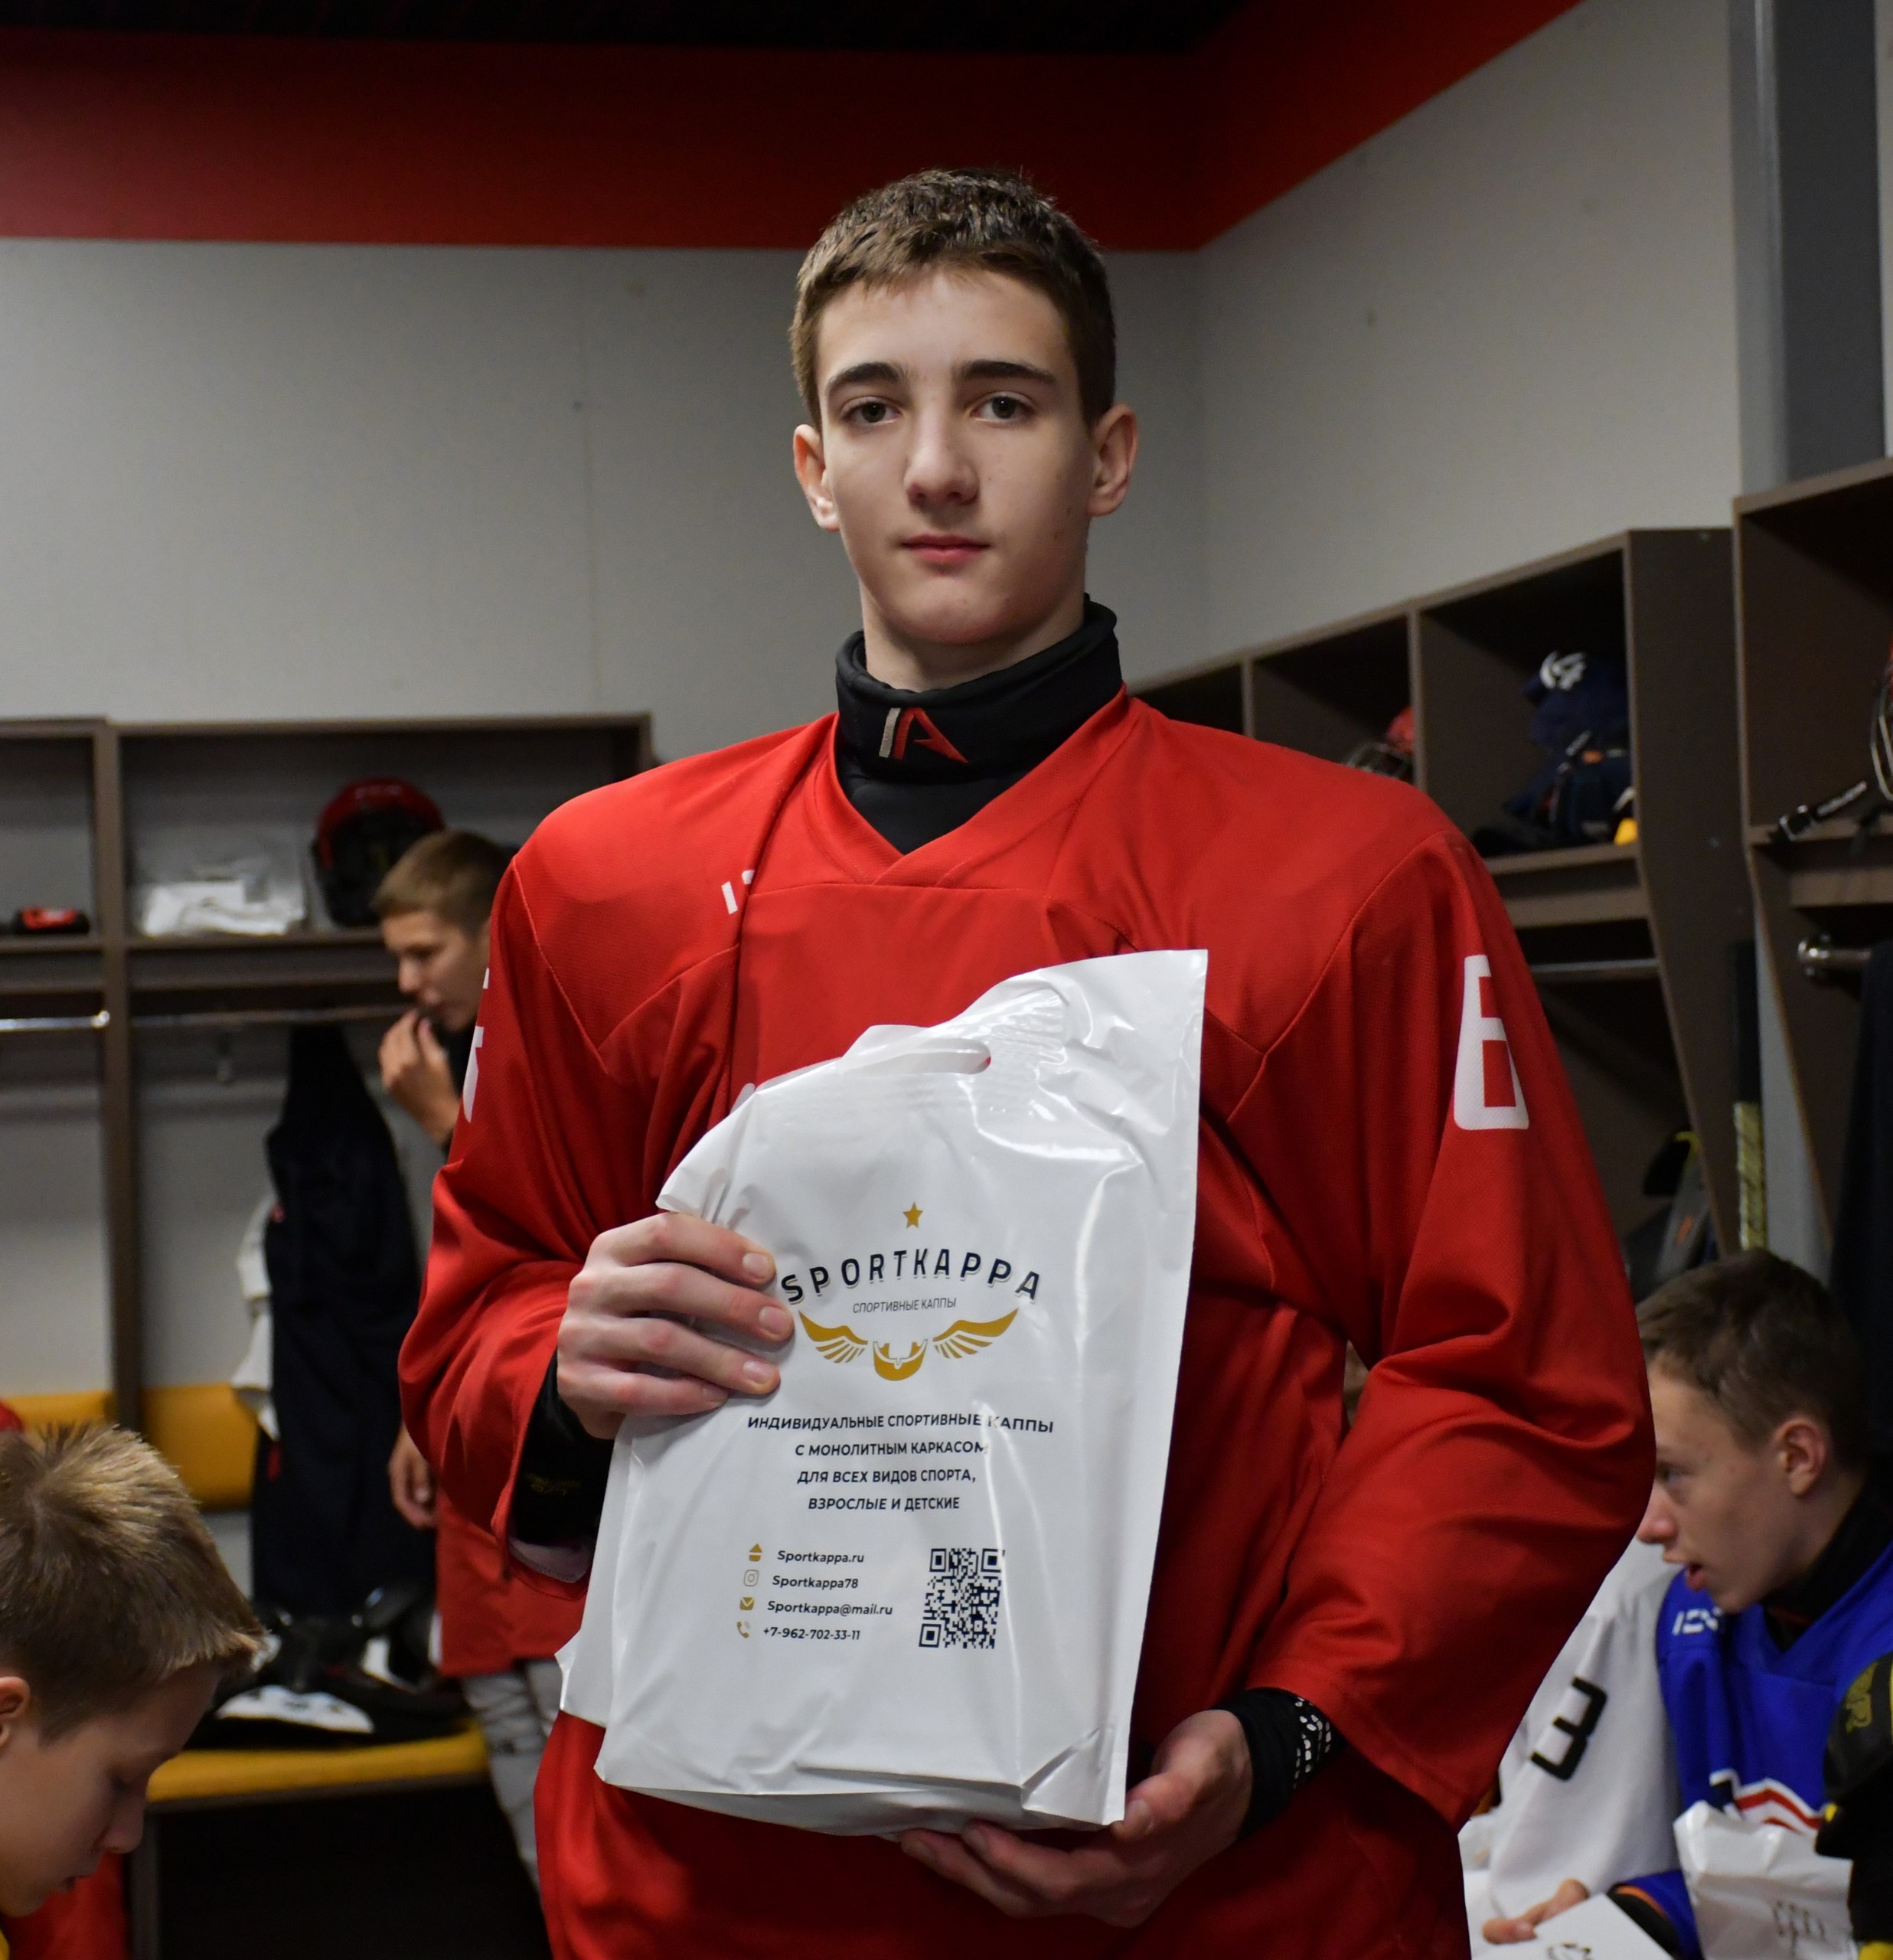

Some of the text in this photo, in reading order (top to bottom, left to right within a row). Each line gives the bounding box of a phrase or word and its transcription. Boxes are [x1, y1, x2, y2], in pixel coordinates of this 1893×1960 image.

[1454, 954, 1529, 1131] 6
[781, 1248, 1041, 1303] SPORTKAPPA
[852, 1297, 957, 1314] СПОРТИВНЫЕ КАППЫ
[747, 1416, 884, 1431] ИНДИВИДУАЛЬНЫЕ
[887, 1413, 982, 1428] СПОРТИВНЫЕ
[795, 1440, 989, 1456] С МОНОЛИТНЫМ КАРКАСОМ
[796, 1468, 976, 1485] ДЛЯ ВСЕХ ВИДОВ СПОРТА,
[808, 1497, 960, 1512] ВЗРОСЛЫЕ И ДЕТСКИЕ
[777, 1550, 865, 1565] Sportkappa.ru
[772, 1575, 859, 1590] Sportkappa78
[766, 1600, 893, 1617] Sportkappa@mail.ru
[763, 1626, 861, 1640] +7-962-702-33-11
